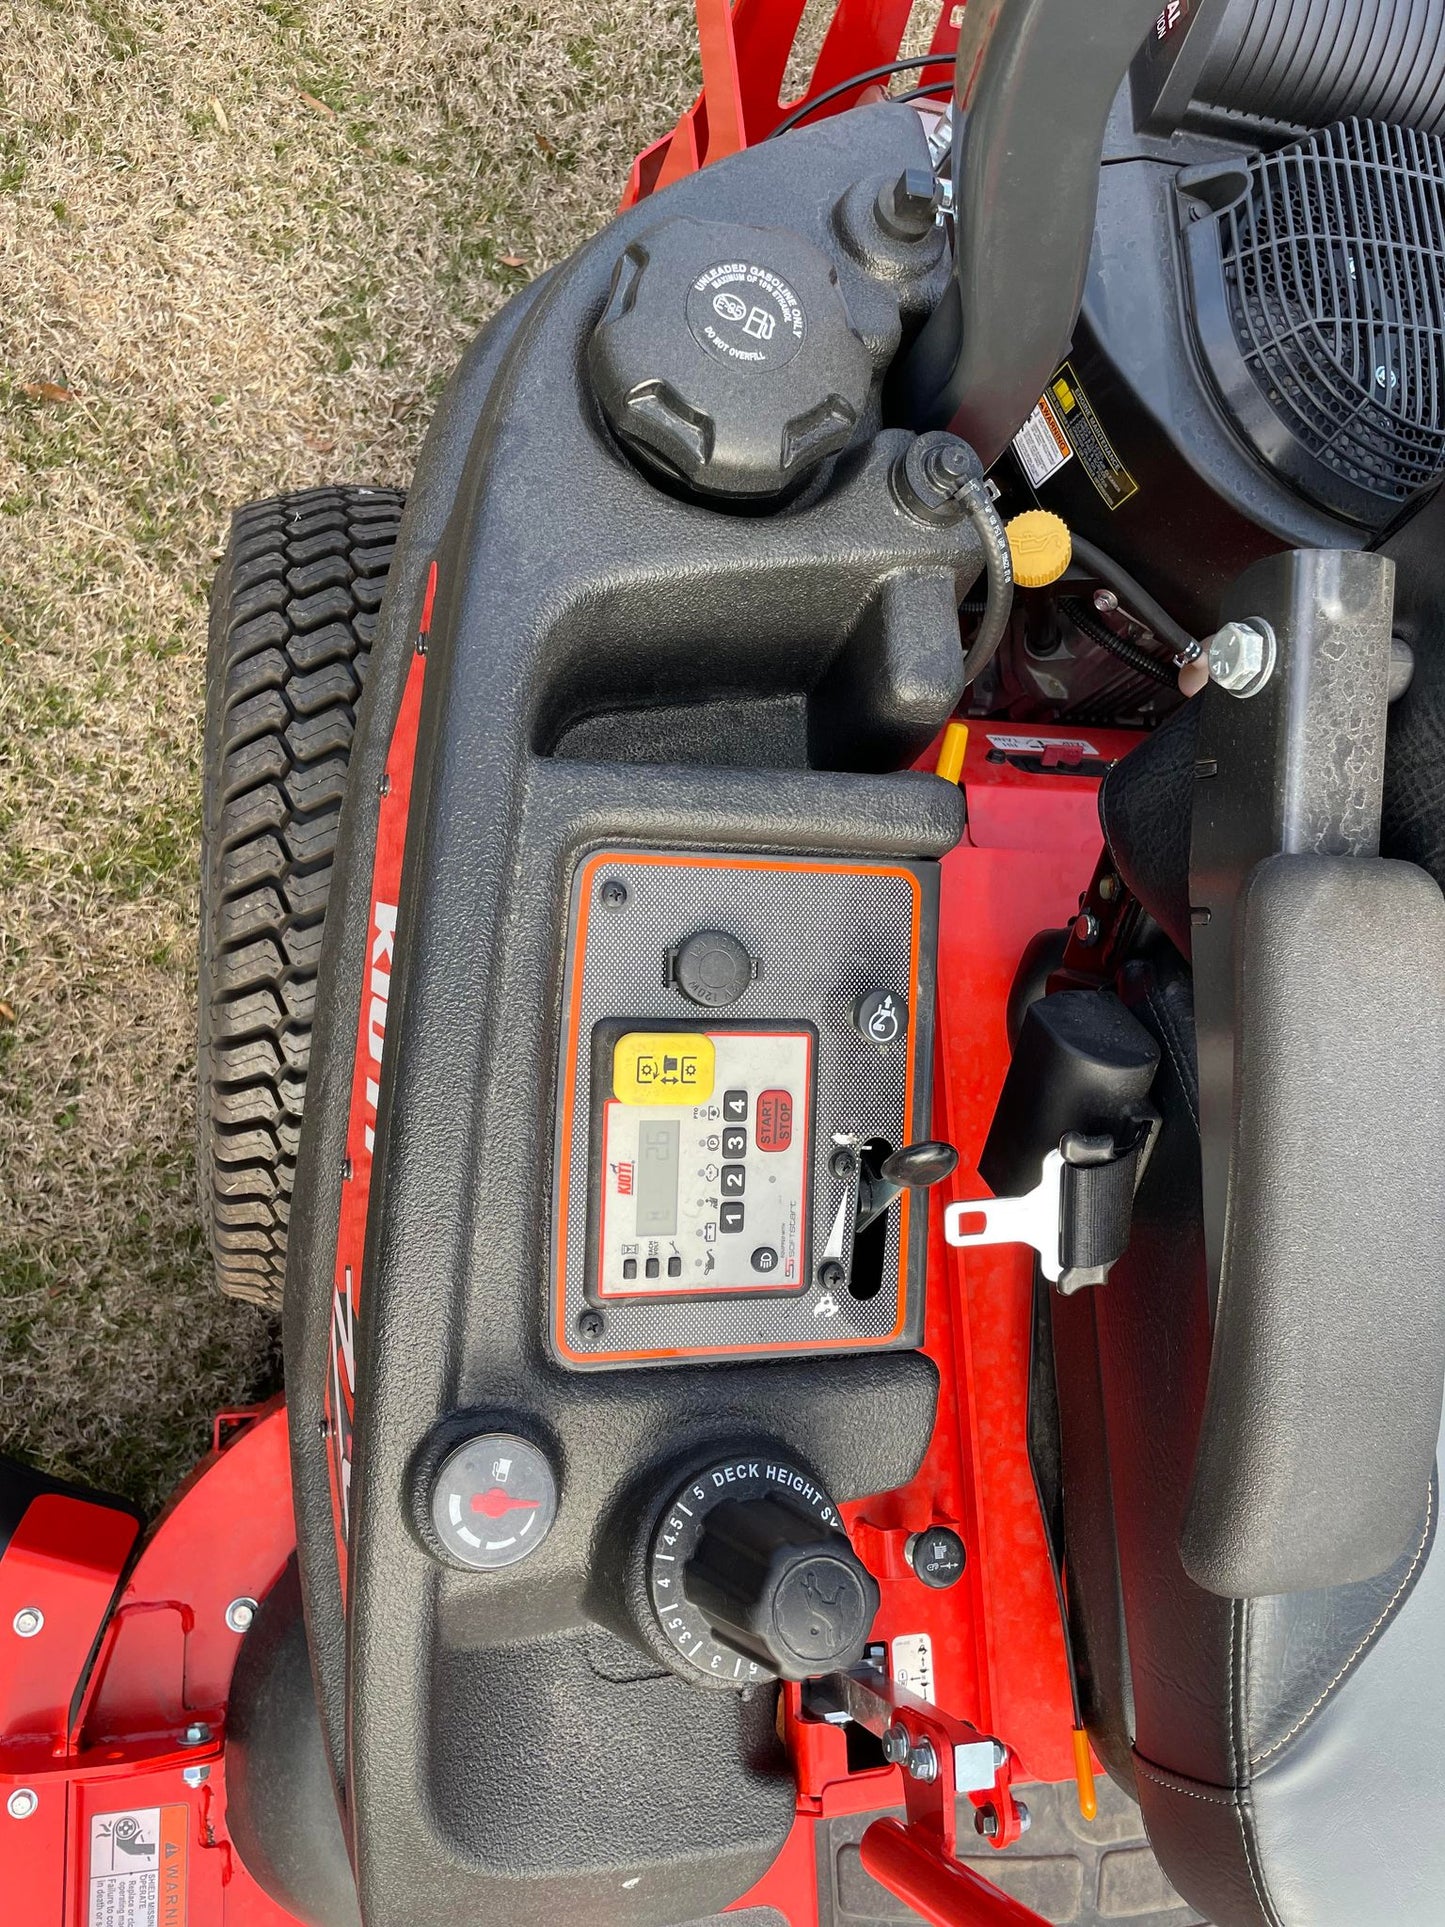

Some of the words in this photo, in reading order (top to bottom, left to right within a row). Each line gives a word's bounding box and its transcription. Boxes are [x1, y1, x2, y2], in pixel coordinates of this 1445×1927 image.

[710, 274, 745, 289] MAXIMUM
[746, 275, 758, 283] OF
[694, 263, 747, 291] UNLEADED
[750, 266, 798, 308] GASOLINE
[792, 308, 803, 339] ONLY
[716, 299, 743, 317] E-85
[704, 326, 716, 339] DO
[713, 337, 729, 352] NOT
[728, 348, 766, 361] OVERFILL
[1042, 406, 1066, 451] WARNING
[728, 1099, 746, 1113] 4
[760, 1098, 773, 1145] START
[779, 1103, 791, 1140] STOP
[727, 1136, 744, 1150] 3
[617, 1162, 632, 1195] KIOTI
[726, 1173, 743, 1188] 2
[726, 1215, 742, 1226] 1
[693, 1485, 705, 1500] 5
[711, 1463, 760, 1488] DECK
[765, 1465, 823, 1507] HEIGHT
[664, 1516, 684, 1548] 4.5
[657, 1577, 672, 1589] 4
[668, 1616, 692, 1644] 3.5
[710, 1654, 722, 1669] 3
[96, 1889, 106, 1910] death
[106, 1878, 116, 1904] Failure
[116, 1881, 126, 1914] operating
[126, 1879, 136, 1907] Replace
[138, 1874, 147, 1909] OPERATE
[147, 1873, 155, 1900] SHIELD
[95, 1911, 102, 1920] or
[106, 1905, 114, 1914] to
[127, 1908, 134, 1916] or
